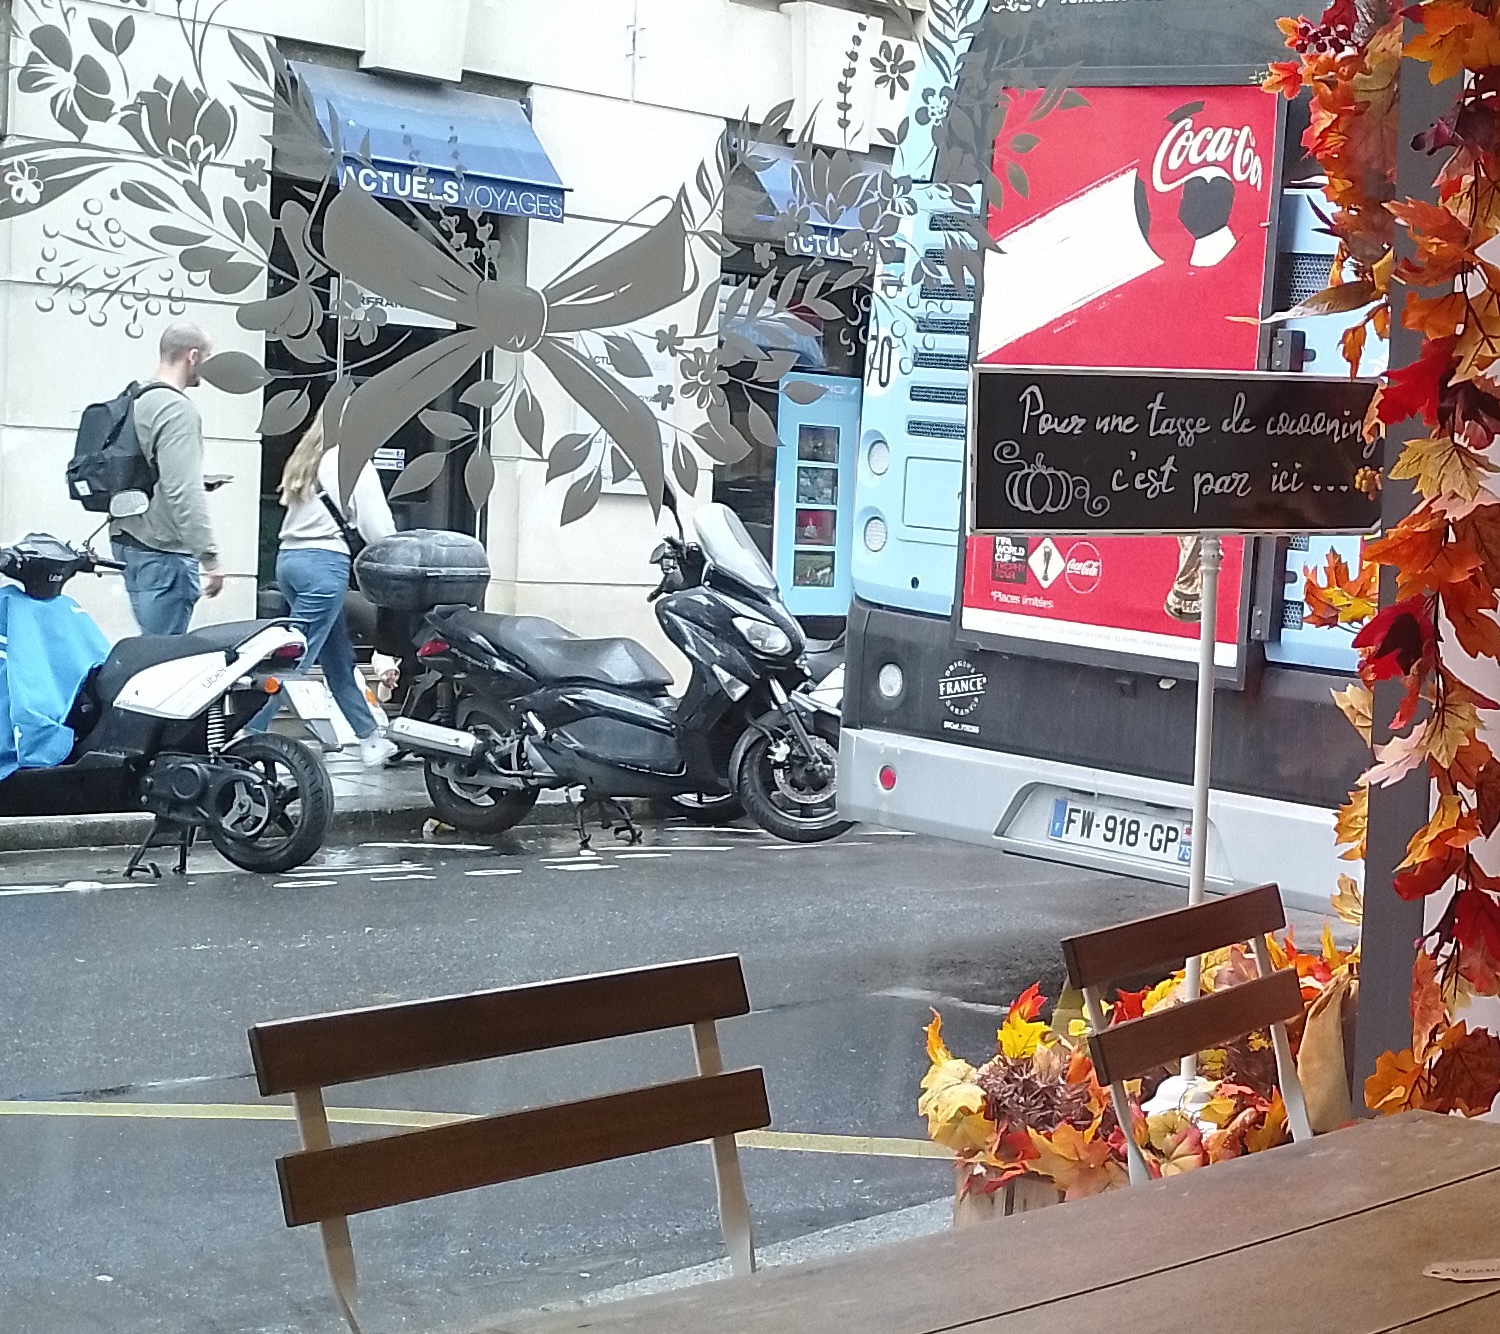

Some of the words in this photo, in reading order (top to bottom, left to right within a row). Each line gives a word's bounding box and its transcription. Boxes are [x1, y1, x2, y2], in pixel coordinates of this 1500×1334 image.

[464, 183, 563, 217] VOYAGES
[1018, 384, 1087, 435] Pour
[1095, 414, 1140, 433] une
[1147, 391, 1211, 447] tasse
[1221, 391, 1256, 434] de
[1111, 449, 1178, 499] c'est
[1192, 469, 1252, 514] par
[1270, 461, 1304, 492] ici
[995, 553, 1011, 562] CUP
[996, 546, 1025, 556] WORLD
[939, 677, 983, 696] FRANCE
[1053, 822, 1061, 832] F
[1065, 807, 1179, 854] FW-918-GP
[1179, 843, 1192, 859] 75
